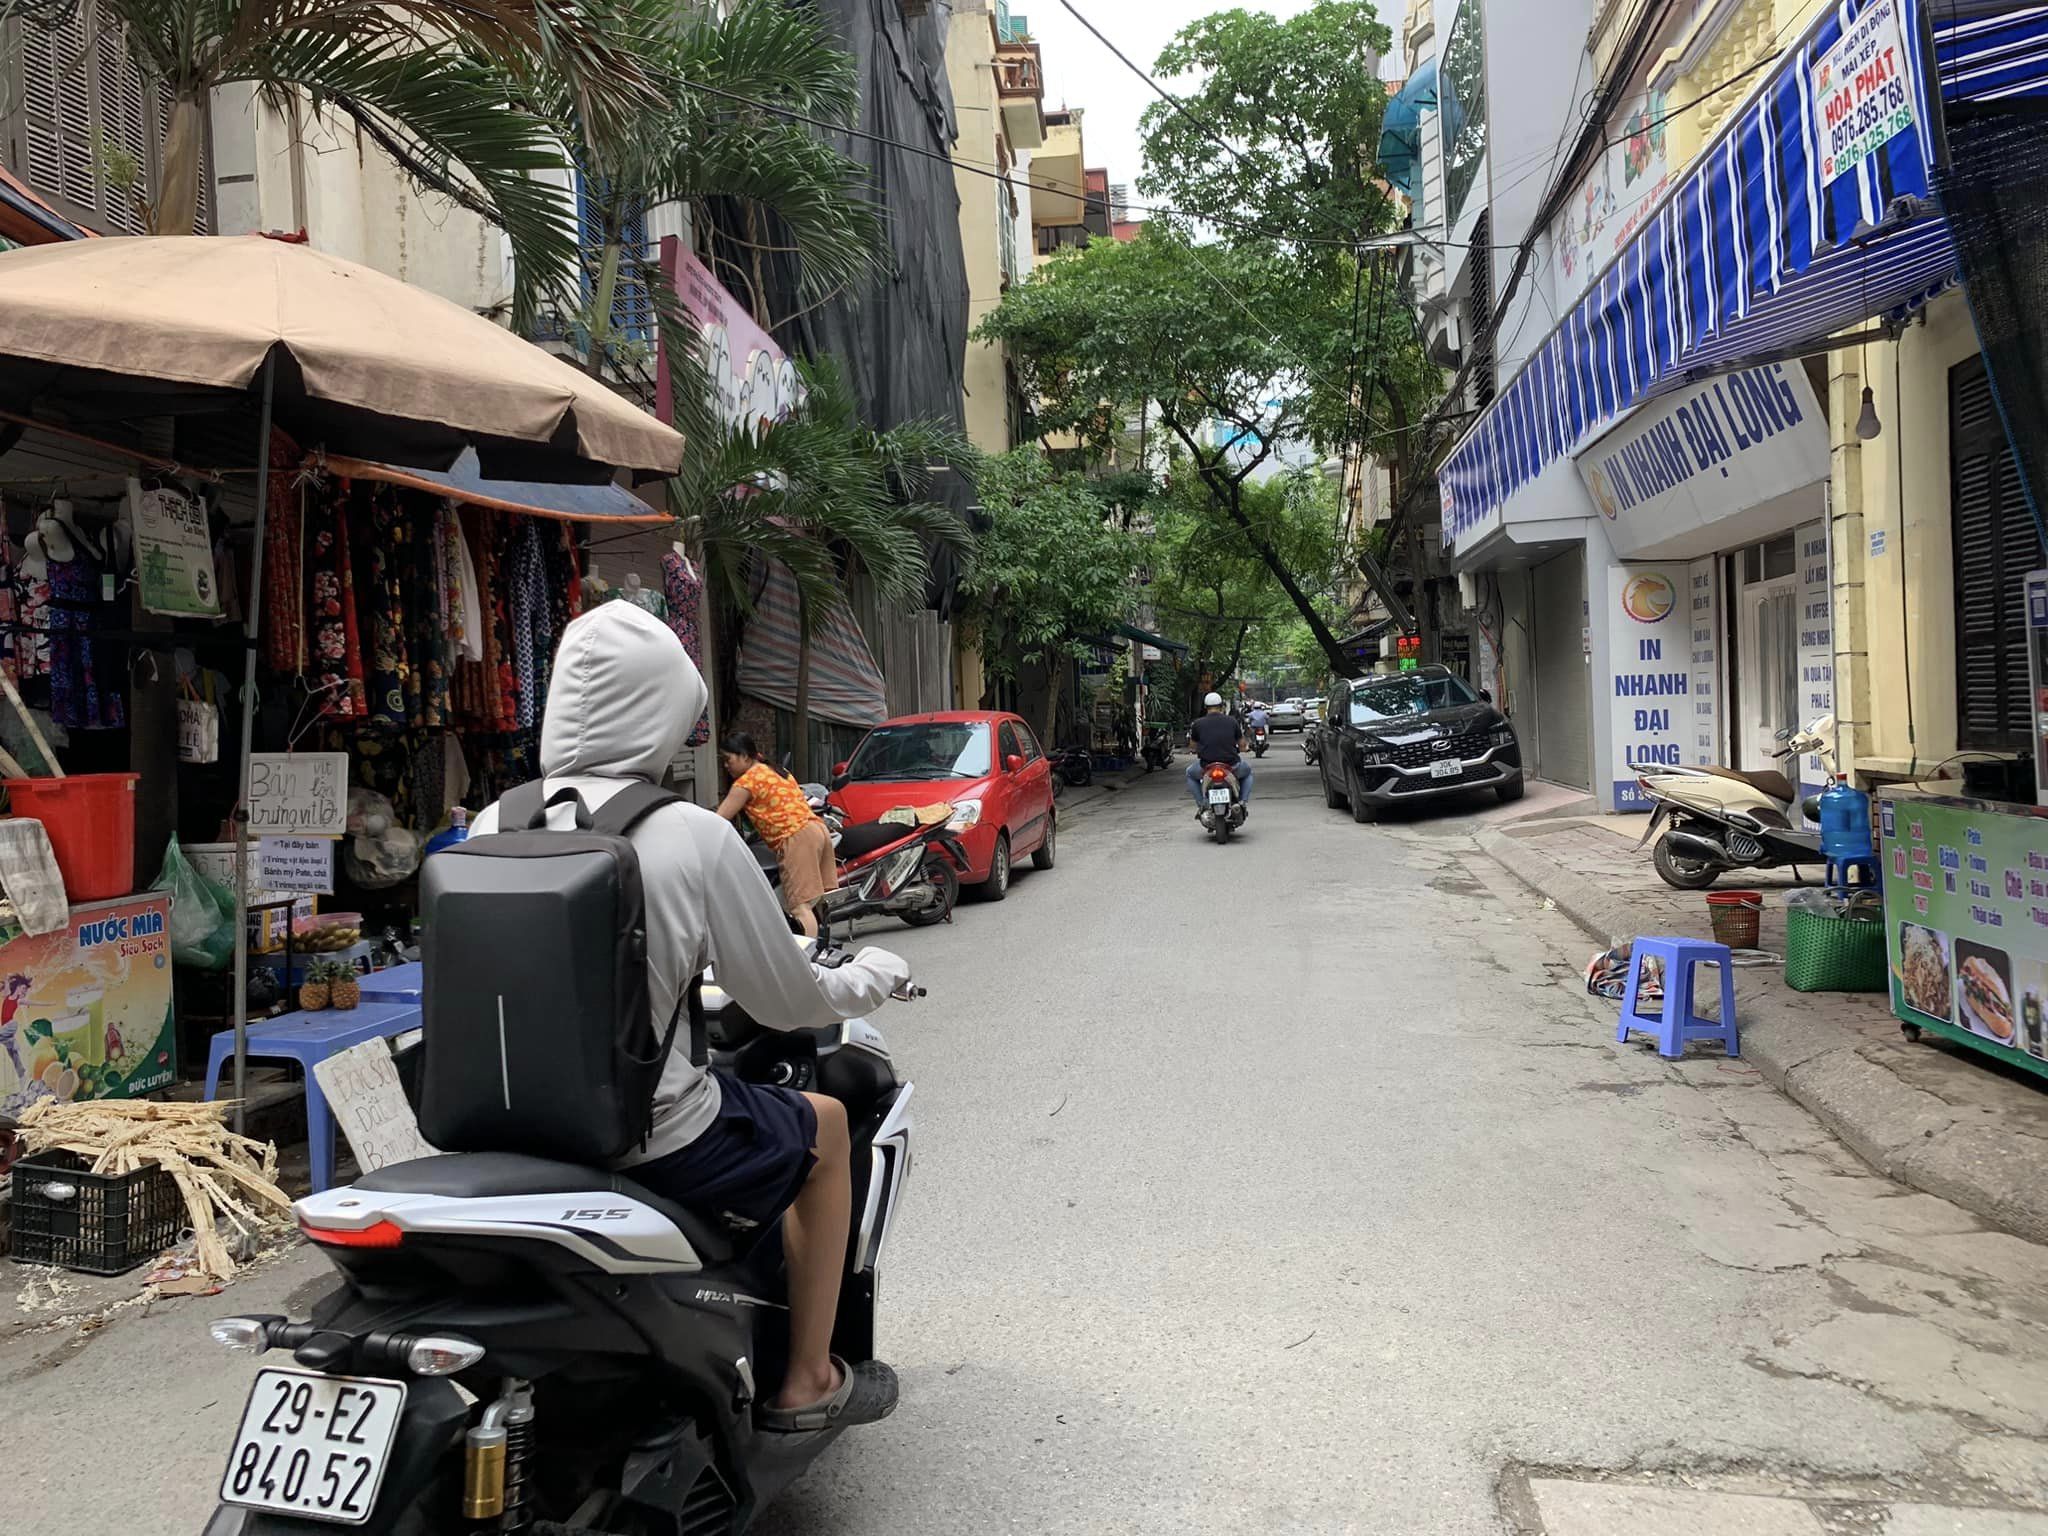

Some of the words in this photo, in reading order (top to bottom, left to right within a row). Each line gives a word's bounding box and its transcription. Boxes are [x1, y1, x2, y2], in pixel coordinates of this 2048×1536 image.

[1860, 23, 1869, 39] DI
[1869, 2, 1891, 30] ĐỘNG
[1859, 38, 1877, 64] XẾP
[1825, 87, 1853, 130] HÒA
[1855, 46, 1896, 104] PHÁT
[1831, 75, 1904, 155] 0976.285.768
[1834, 104, 1912, 176] 0976.125.768
[1604, 454, 1637, 511] IN
[1621, 416, 1694, 502] NHANH
[1676, 391, 1733, 478] ĐẠI
[1713, 363, 1803, 450] LONG
[1812, 602, 1829, 619] OFFSE
[1639, 639, 1661, 660] IN
[1615, 673, 1688, 696] NHANH
[1811, 693, 1822, 709] PHA
[1634, 709, 1669, 735] ĐẠI
[1626, 744, 1680, 765] LONG
[250, 762, 297, 798] Bán
[249, 797, 297, 832] Trứng
[1939, 847, 1960, 869] Bánh
[79, 913, 128, 947] NƯỚC
[132, 906, 164, 937] MÍA
[141, 937, 164, 955] Sạch
[561, 1208, 634, 1221] 155
[262, 1380, 376, 1445] 29-E2
[233, 1442, 371, 1513] 840.52
